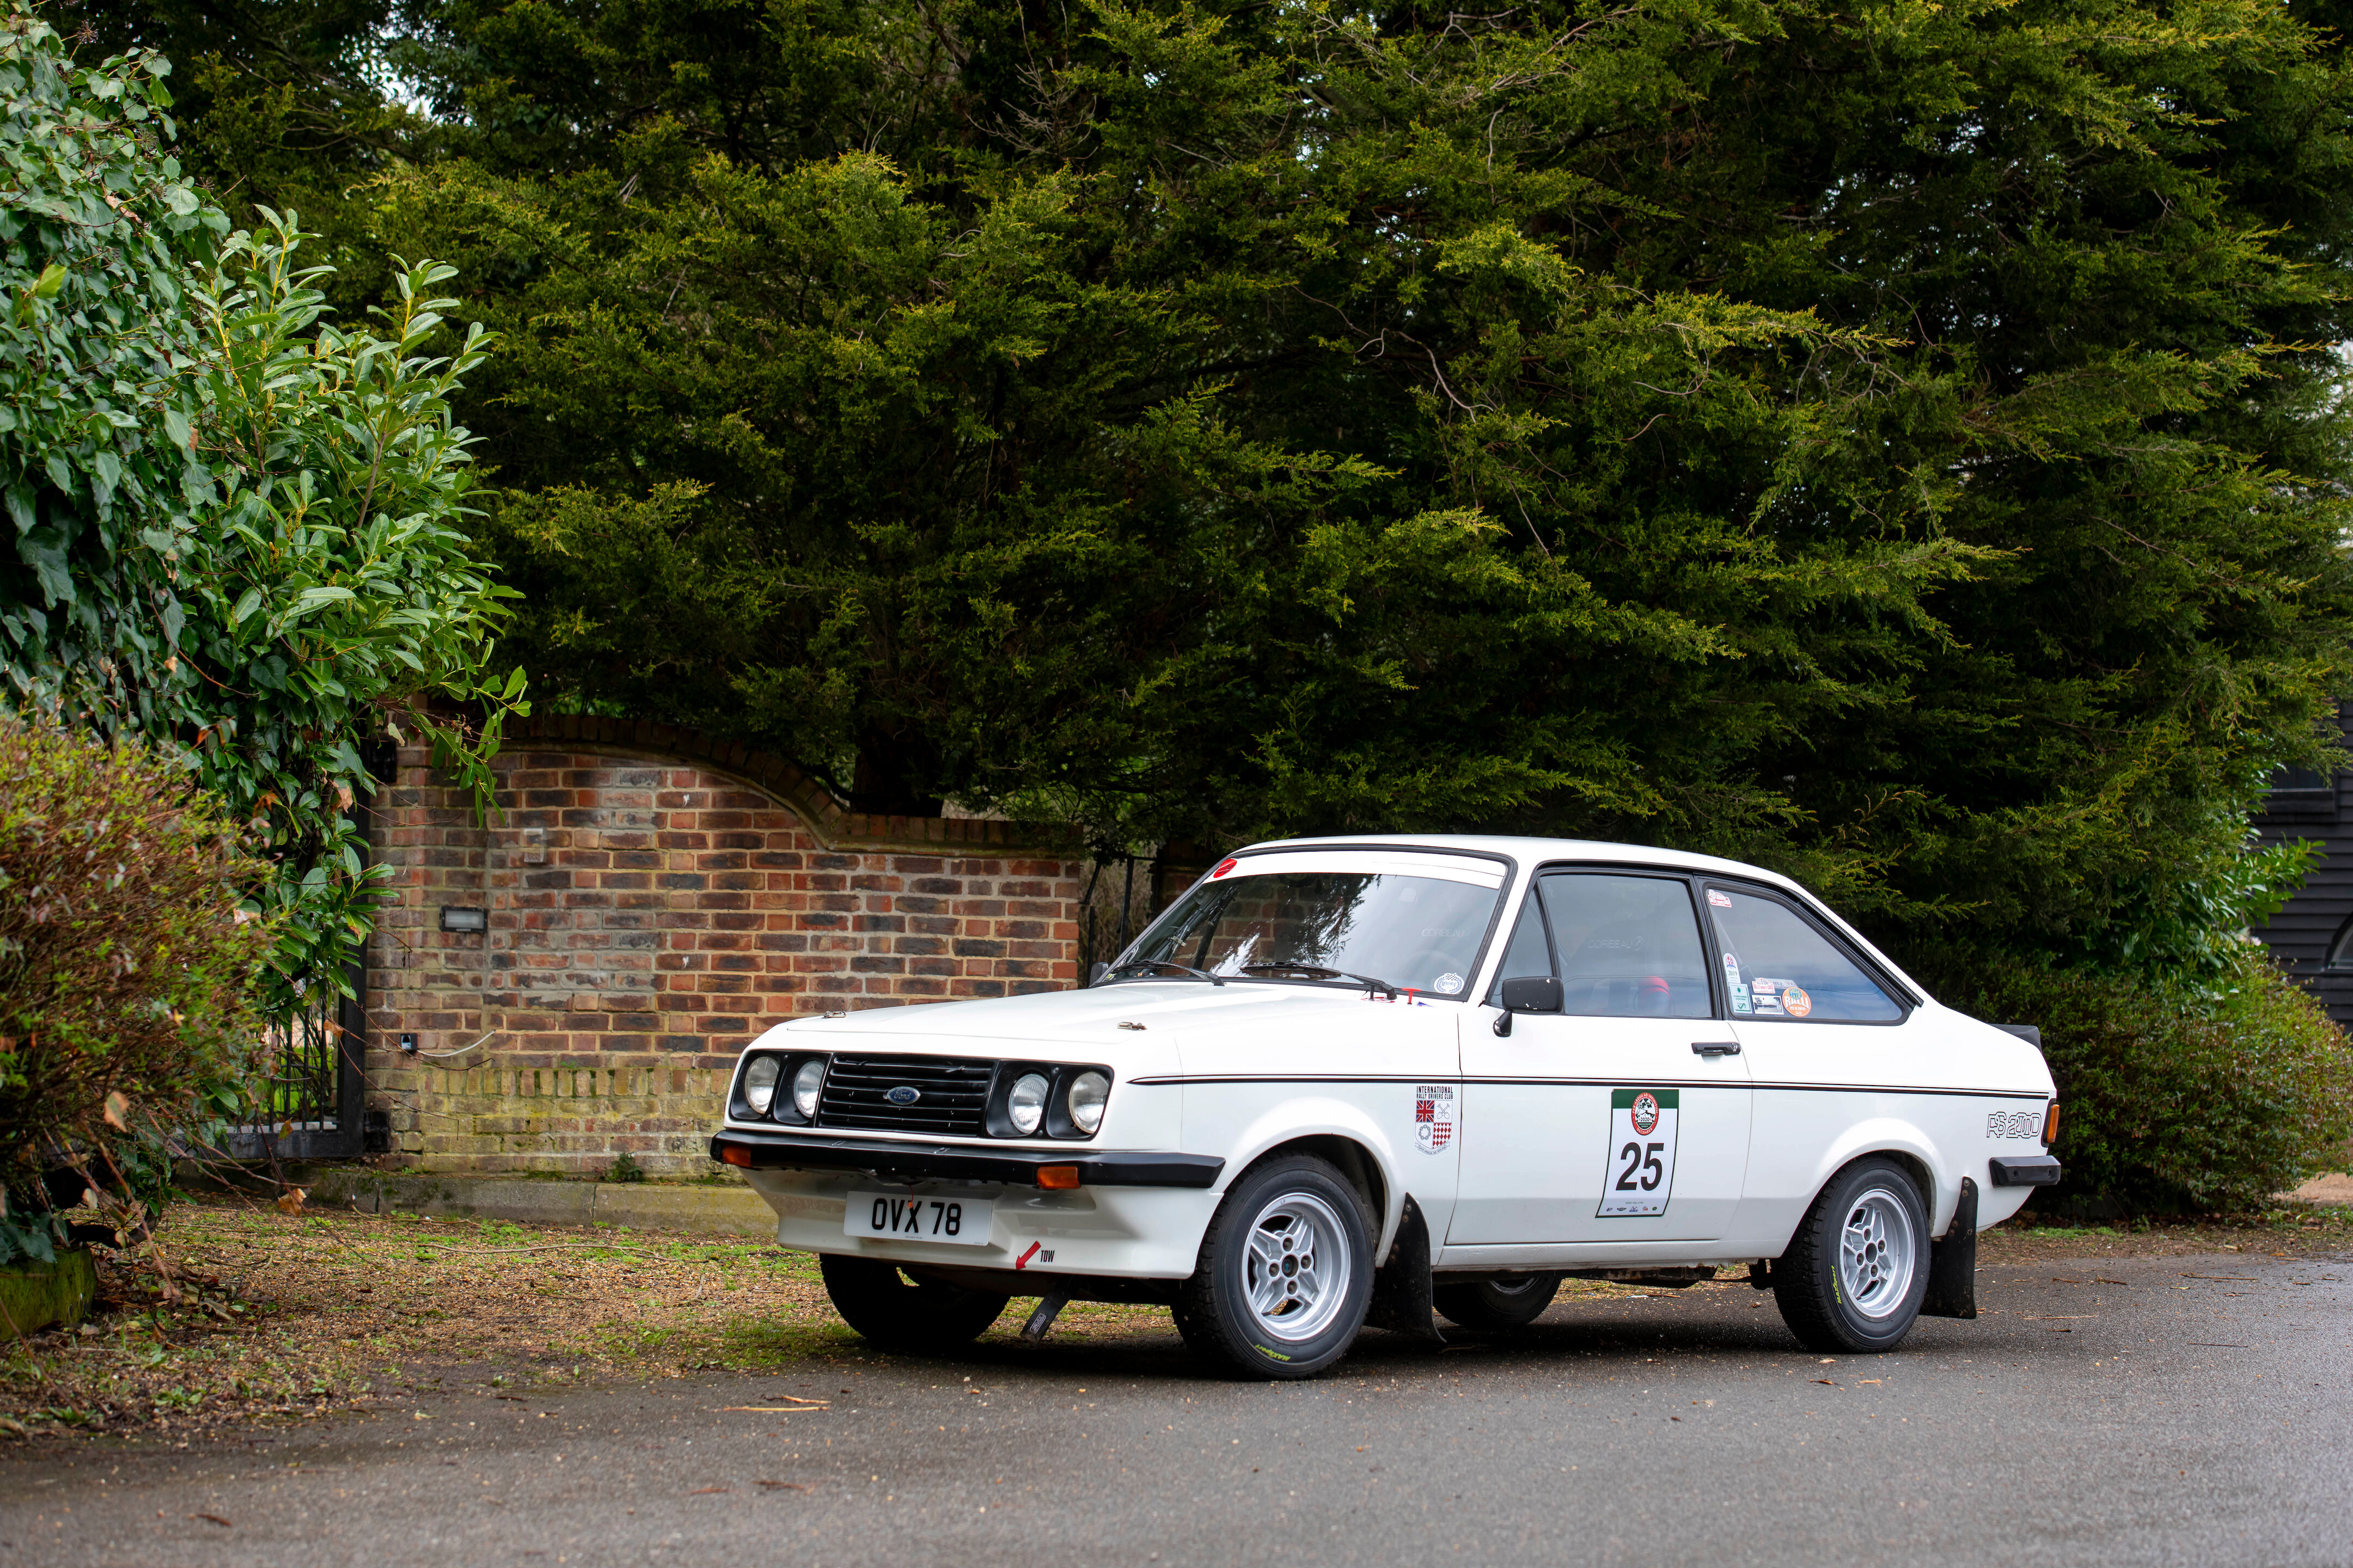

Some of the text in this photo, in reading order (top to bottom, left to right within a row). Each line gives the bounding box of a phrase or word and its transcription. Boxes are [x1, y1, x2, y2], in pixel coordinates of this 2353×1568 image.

[1784, 996, 1810, 1009] RALLI
[894, 1089, 912, 1100] Ford
[1416, 1086, 1453, 1094] INTERNATIONAL
[1635, 1094, 1643, 1105] ARDUA
[1648, 1094, 1658, 1113] INFINITUM
[1987, 1111, 2042, 1138] RS 2000
[1615, 1142, 1664, 1191] 25
[872, 1198, 962, 1236] OVX 78
[1041, 1250, 1055, 1263] TOW
